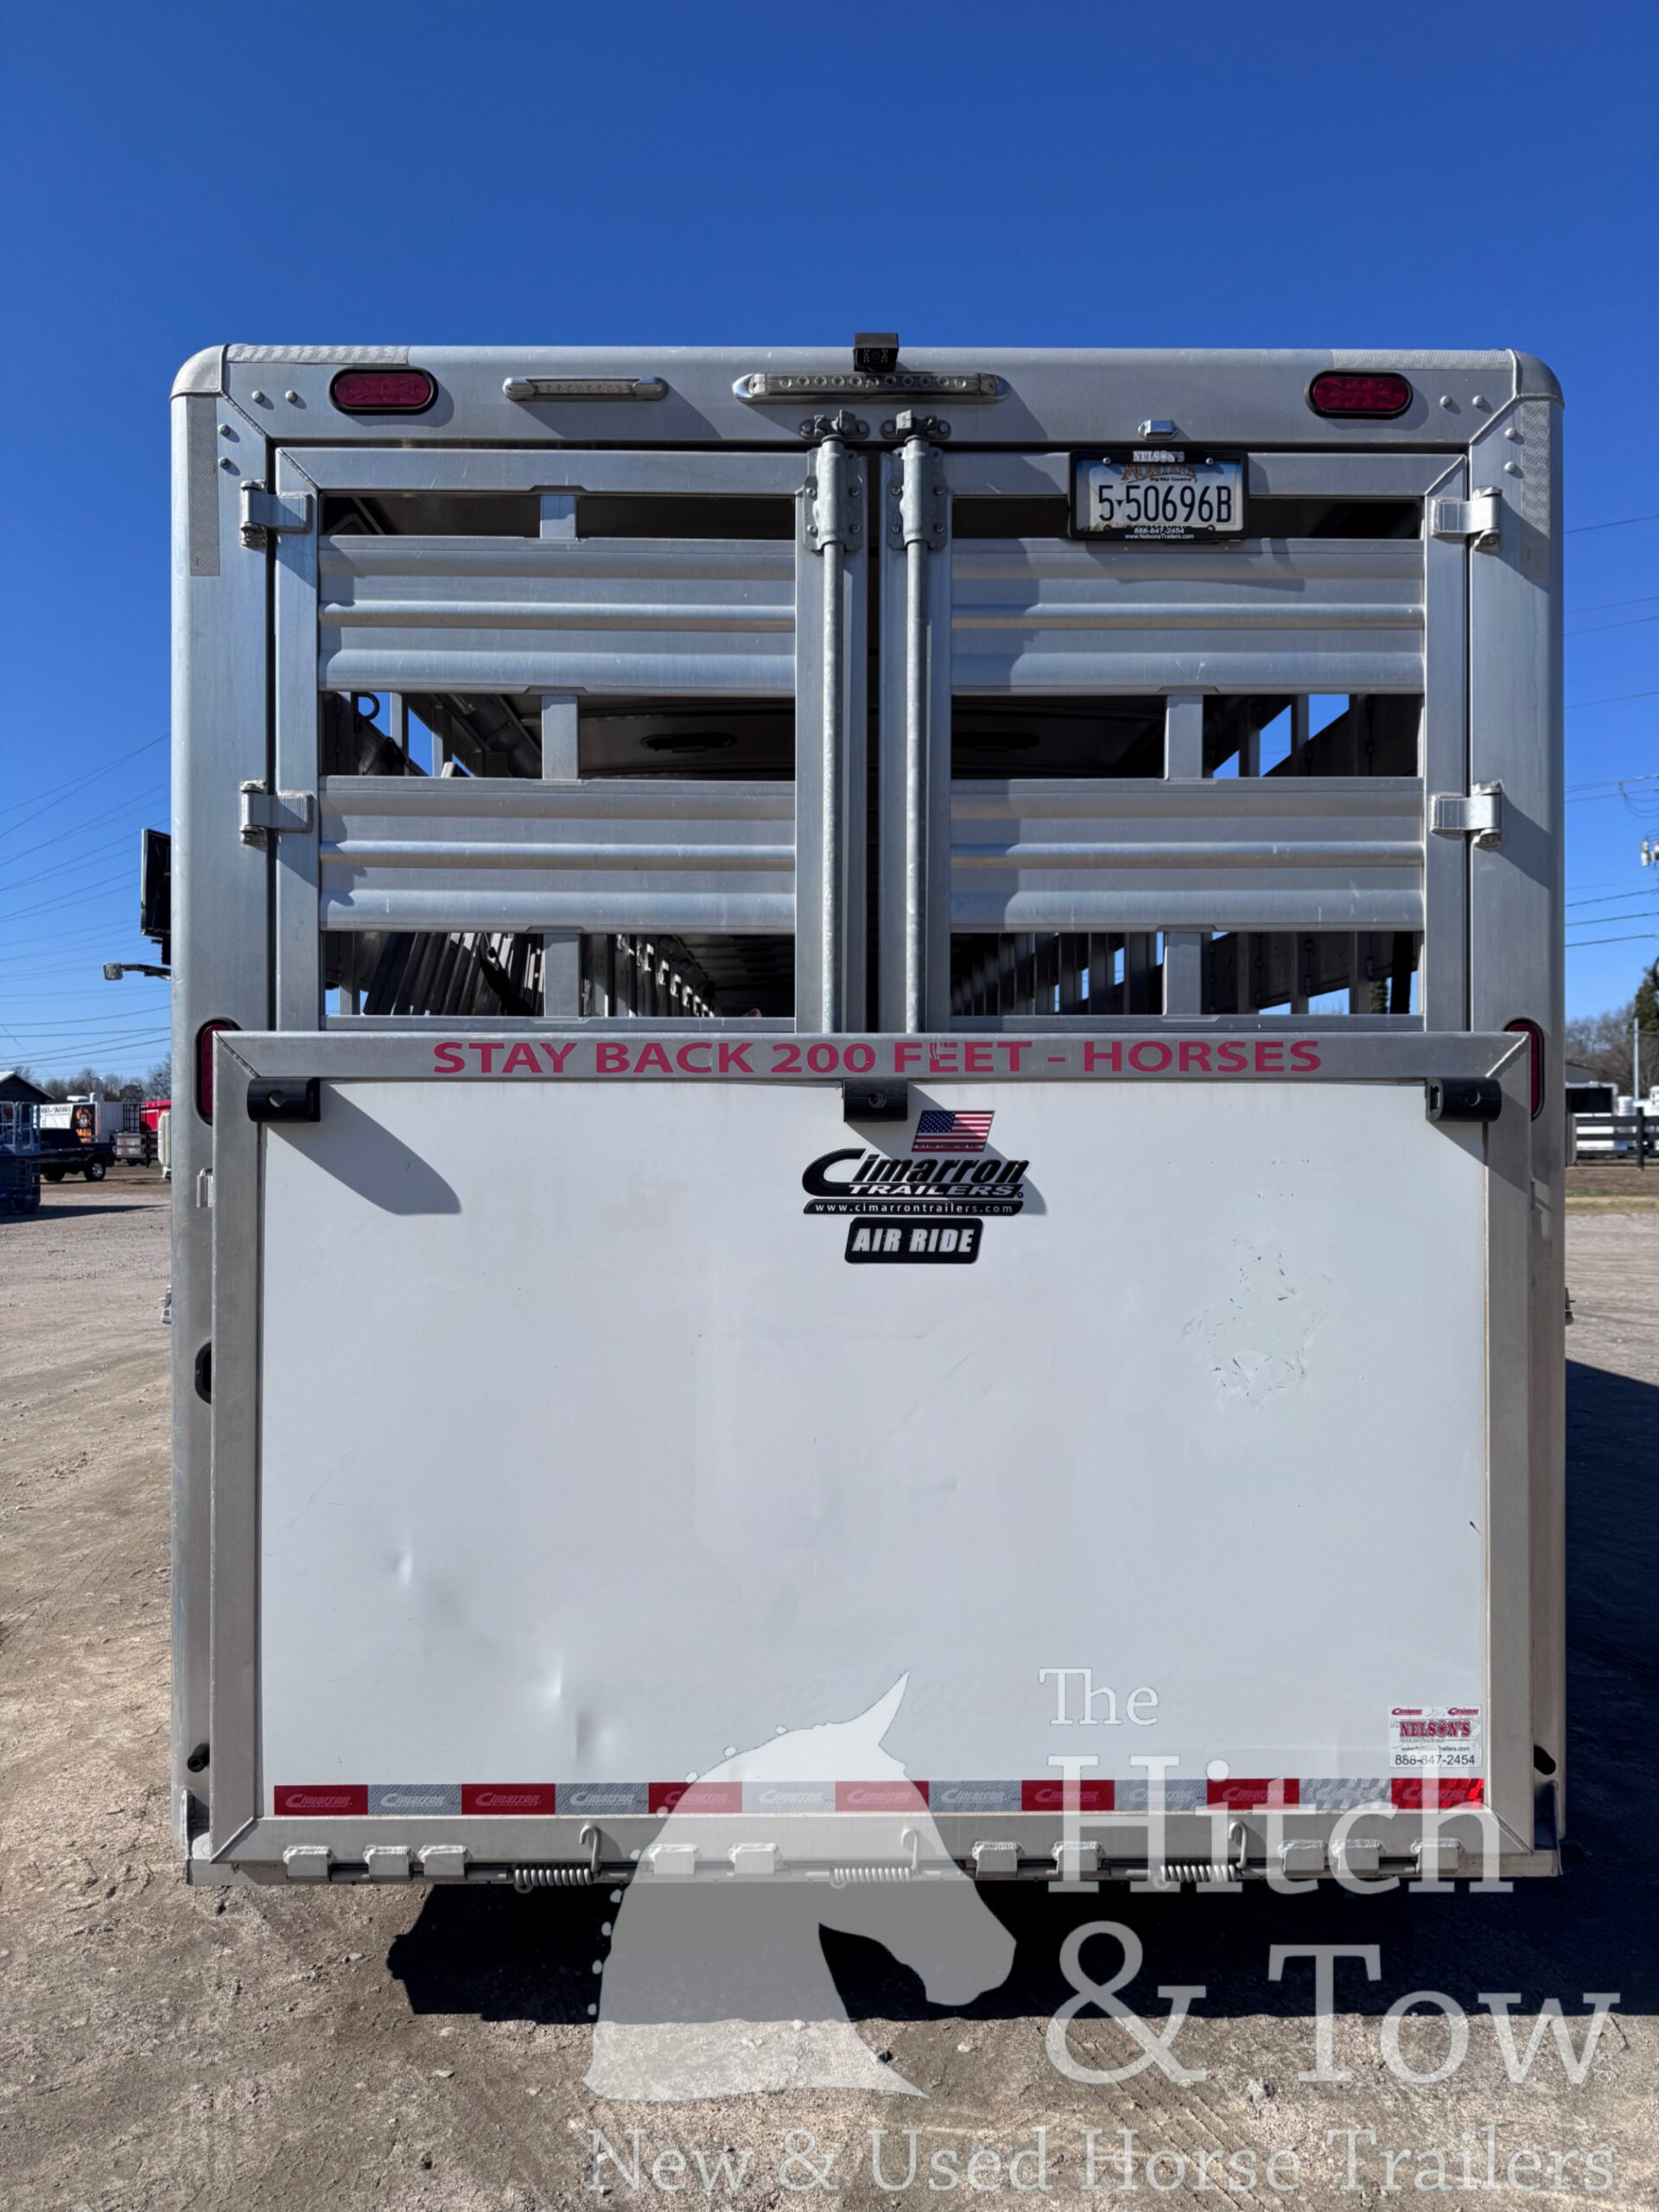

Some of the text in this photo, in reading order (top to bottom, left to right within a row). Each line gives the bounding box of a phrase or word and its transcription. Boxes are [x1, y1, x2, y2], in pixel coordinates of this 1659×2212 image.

[434, 1042, 578, 1074] STAY
[596, 1042, 754, 1074] BACK
[772, 1042, 875, 1074] 200
[893, 1041, 1033, 1072] FEET
[1084, 1040, 1322, 1072] HORSES
[802, 1147, 1030, 1197] Cimarron
[849, 1185, 1014, 1196] TRAILERS
[815, 1202, 1013, 1213] www.cimarrontrailers.com
[851, 1228, 975, 1253] AIR RIDE
[1400, 1720, 1471, 1738] NELSON'S
[1395, 1754, 1475, 1765] 888-847-2454
